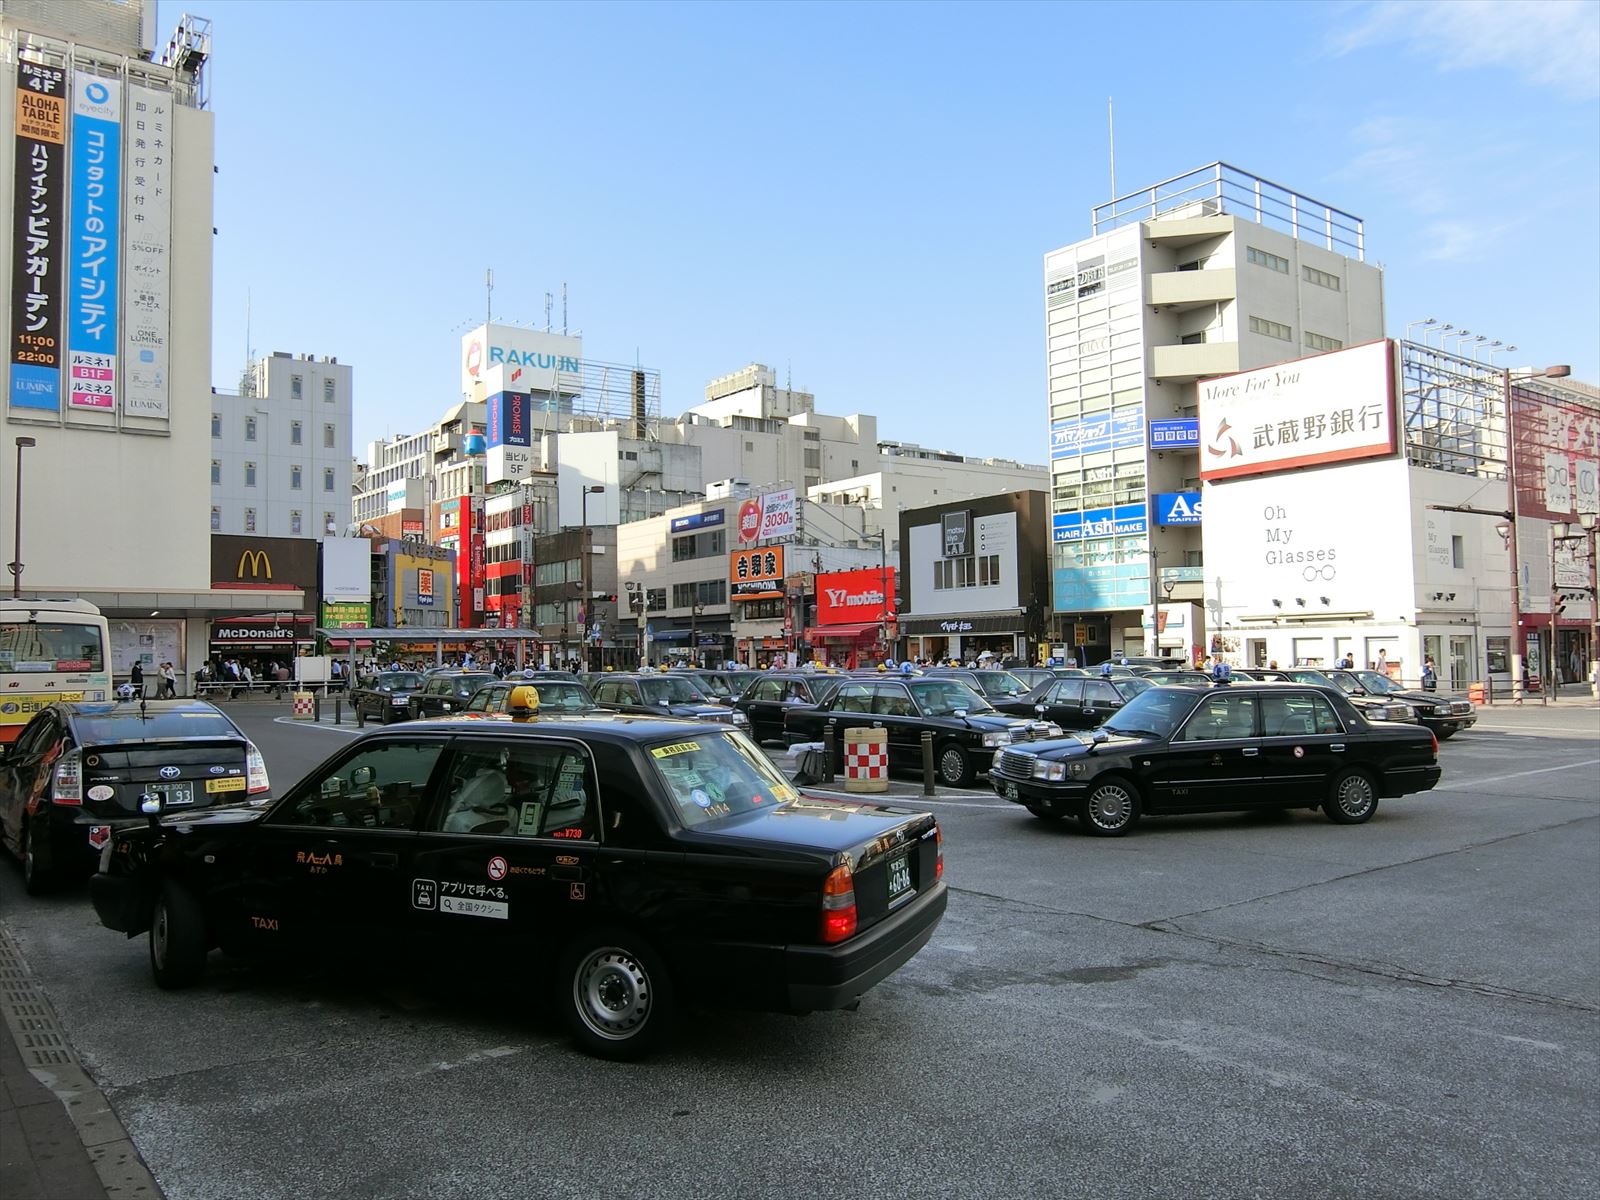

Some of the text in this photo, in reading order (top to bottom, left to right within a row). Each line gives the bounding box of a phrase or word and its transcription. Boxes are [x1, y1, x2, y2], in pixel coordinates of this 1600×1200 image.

[22, 64, 62, 81] ルミネ2
[29, 77, 56, 93] 4F
[22, 94, 60, 113] ALOHA
[79, 103, 114, 117] eyecity
[22, 105, 60, 125] TABLE
[153, 106, 164, 196] ルミネカード
[134, 102, 147, 223] 即日発行受付中
[80, 130, 107, 340] コンタクトのアイシティ
[131, 244, 164, 254] 5%OFF
[134, 264, 161, 274] ポイント
[133, 301, 160, 309] サービス
[18, 334, 55, 347] 11:00
[130, 335, 163, 345] LUMINE
[138, 330, 157, 338] ONE
[17, 350, 55, 364] 22:00
[72, 355, 111, 368] ルミネ1
[80, 368, 105, 378] B1F
[16, 382, 55, 394] LUMINE
[72, 382, 112, 394] ルミネ2
[1204, 370, 1301, 402] More For You
[84, 395, 101, 404] 4F
[130, 399, 163, 410] LUMINE
[511, 394, 523, 434] PROMISE
[1252, 403, 1384, 450] 武蔵野銀行
[504, 451, 529, 462] 当ビル
[510, 464, 524, 474] 5F
[1263, 505, 1287, 521] Oh
[1056, 516, 1143, 539] HAIR Ash MAKE
[1266, 528, 1293, 545] My
[1265, 548, 1337, 565] Glasses
[737, 551, 776, 579] 吉野家
[420, 571, 432, 594] 薬
[217, 628, 294, 639] McDonald's
[703, 803, 731, 817] 1114
[416, 884, 433, 892] TAXI
[440, 881, 509, 900] アプリで呼べる。
[457, 901, 502, 913] 全国タクシー
[251, 915, 279, 930] TAXI
